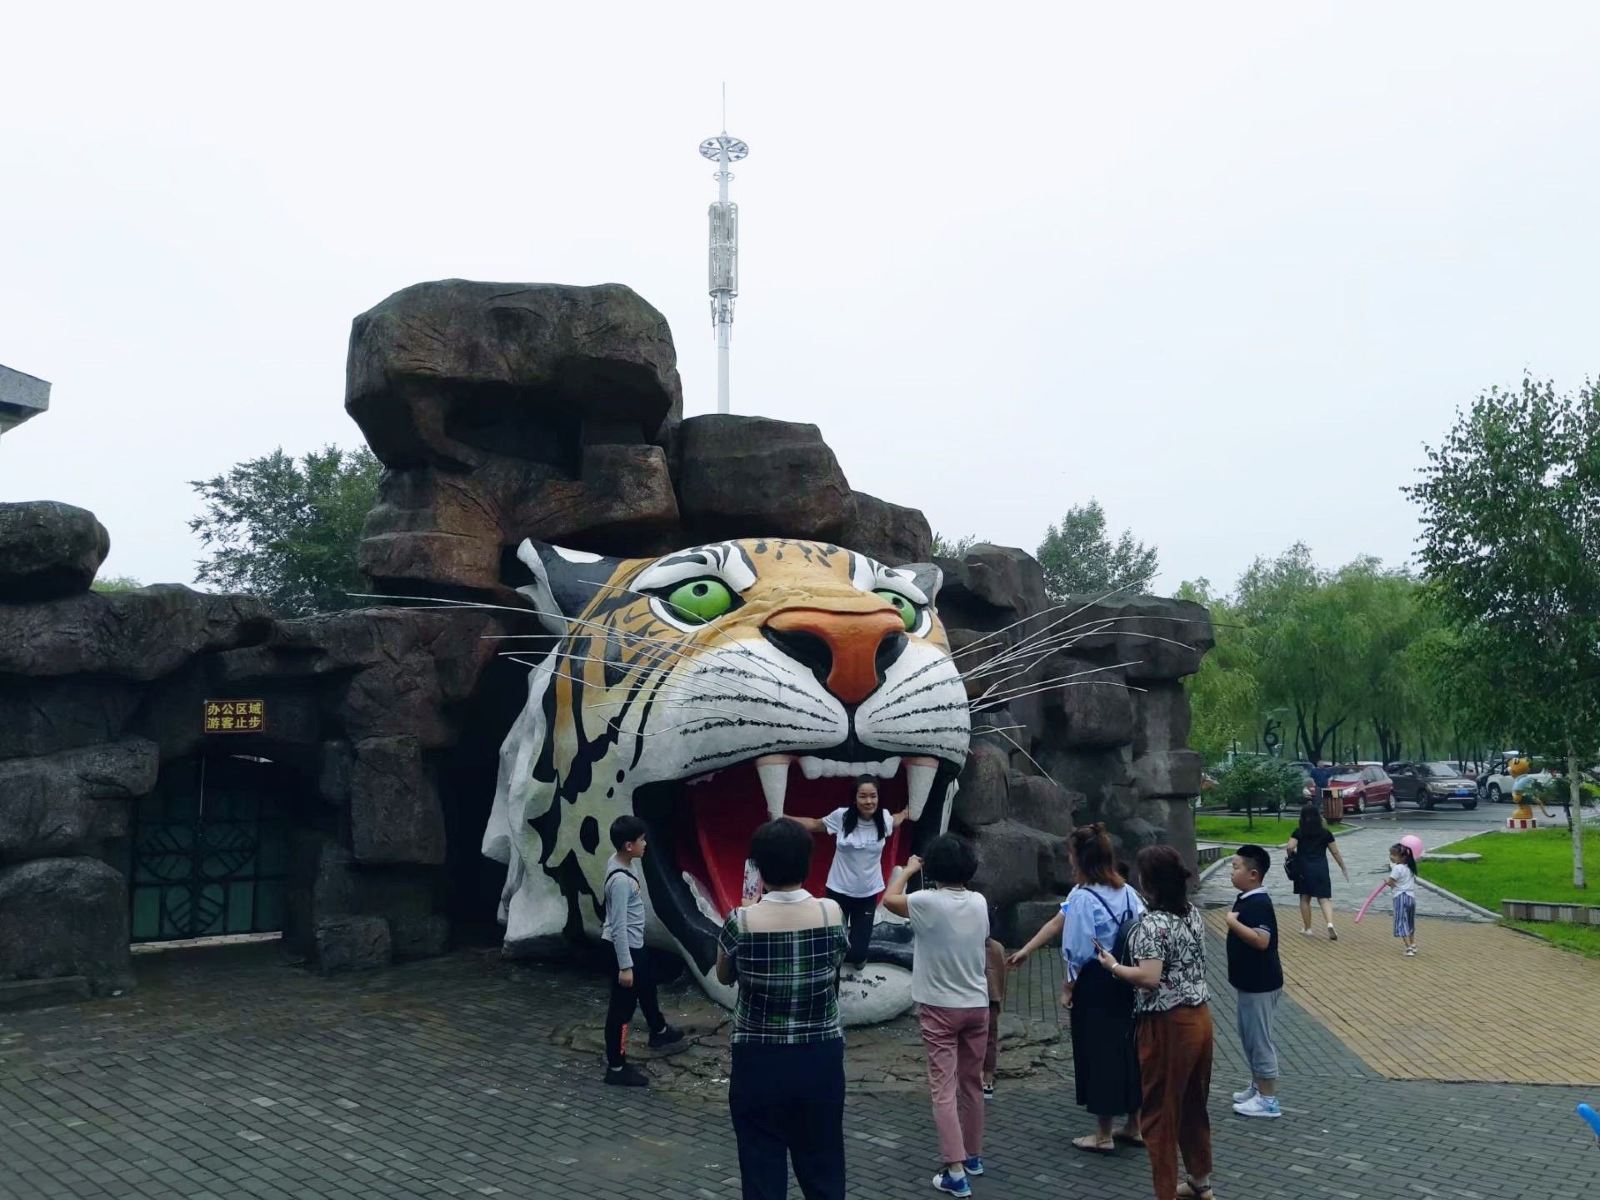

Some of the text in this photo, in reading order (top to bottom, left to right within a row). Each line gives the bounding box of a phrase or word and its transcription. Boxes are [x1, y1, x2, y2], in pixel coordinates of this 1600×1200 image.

[207, 702, 262, 715] 办公区域
[206, 716, 262, 729] 游客止步
